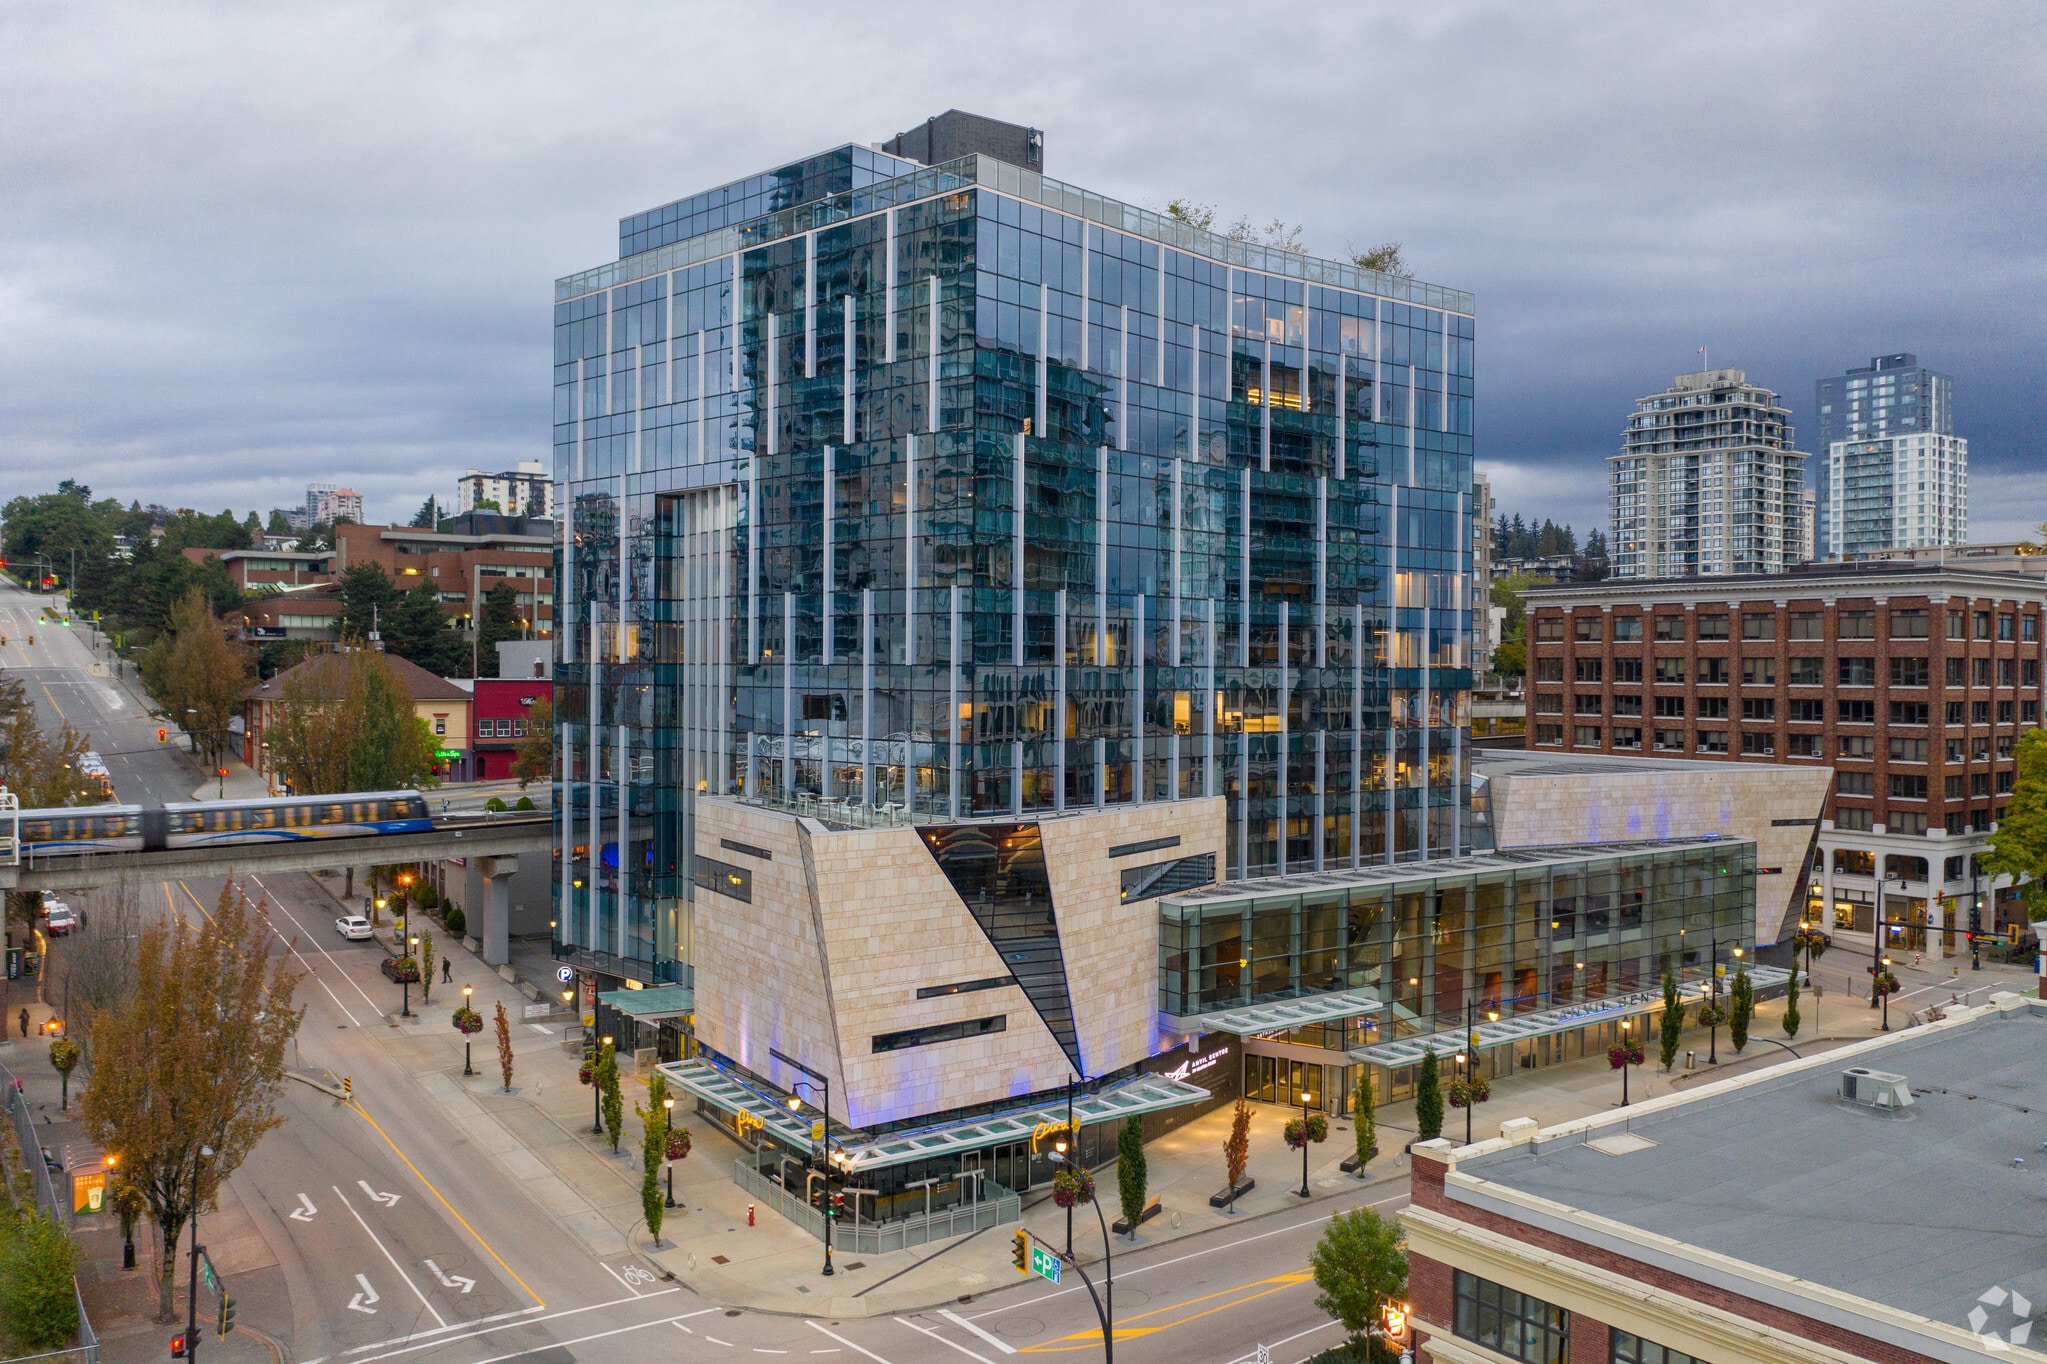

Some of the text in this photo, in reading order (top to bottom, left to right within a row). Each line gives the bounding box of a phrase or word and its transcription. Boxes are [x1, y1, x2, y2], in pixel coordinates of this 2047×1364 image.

[1192, 1056, 1208, 1068] ANVIL
[1209, 1047, 1229, 1061] CENTRE
[1042, 1253, 1052, 1275] P
